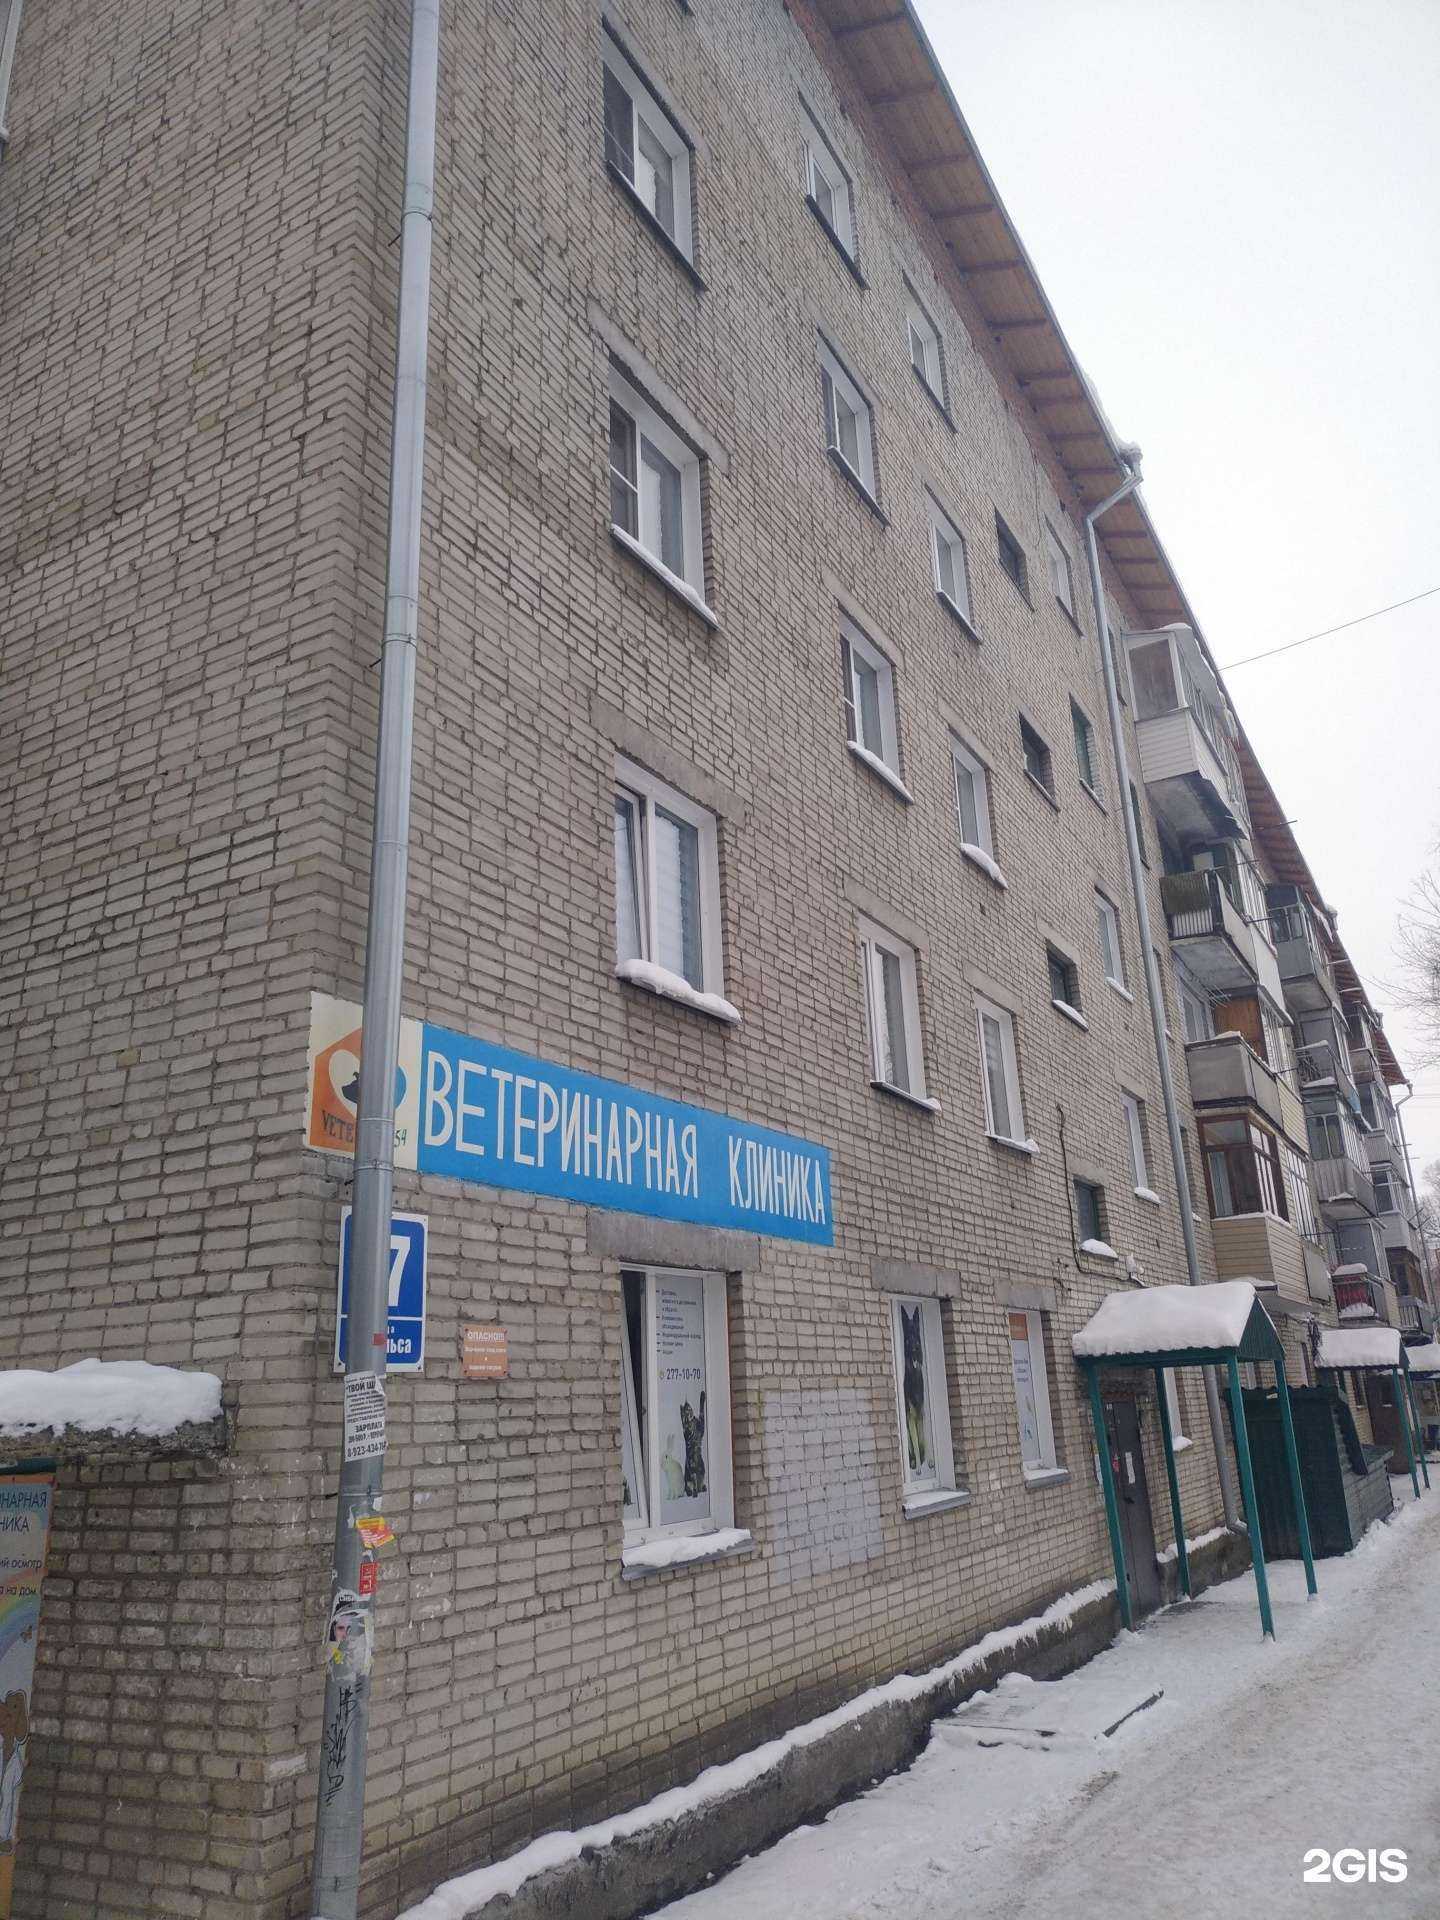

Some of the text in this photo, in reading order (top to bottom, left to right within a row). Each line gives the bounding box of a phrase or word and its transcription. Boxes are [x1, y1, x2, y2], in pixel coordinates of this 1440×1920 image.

[424, 1050, 826, 1225] ВЕТЕРИНАРНАЯ КЛИНИКА
[387, 1234, 411, 1307] 7
[666, 1368, 701, 1380] 277-10-70
[0, 1515, 29, 1532] НИКА
